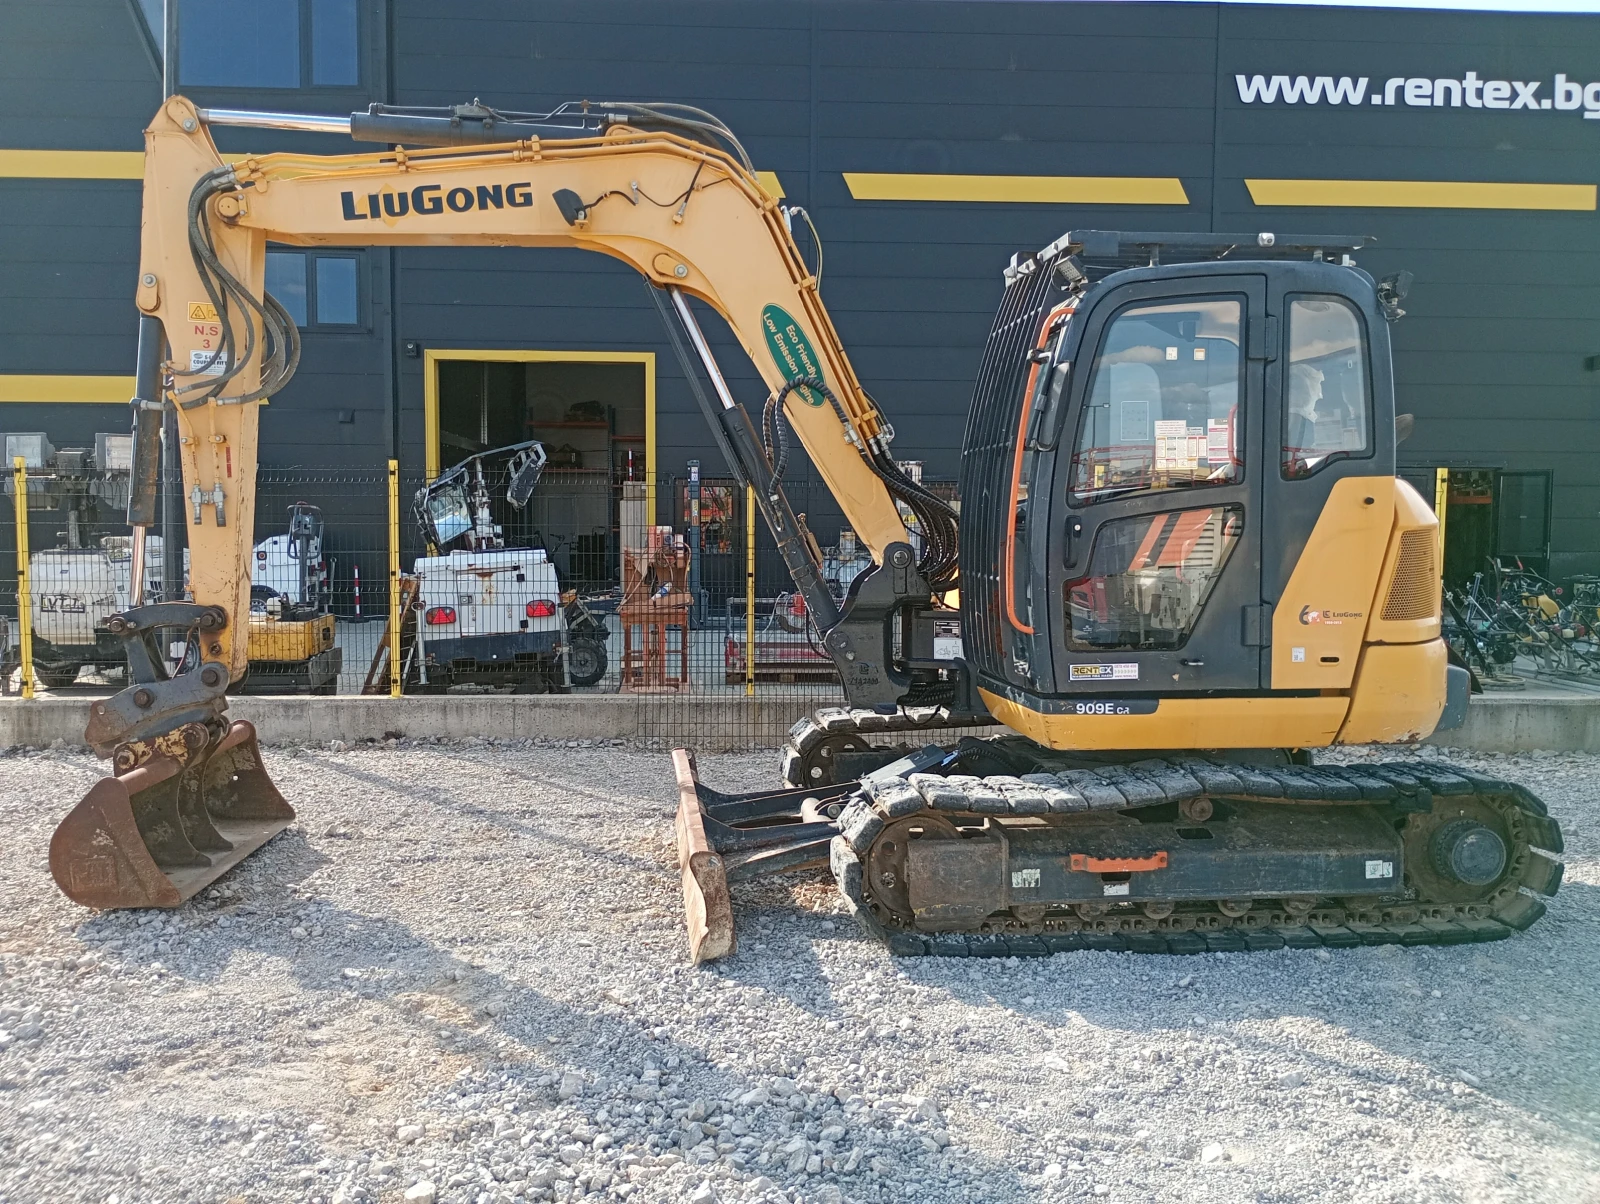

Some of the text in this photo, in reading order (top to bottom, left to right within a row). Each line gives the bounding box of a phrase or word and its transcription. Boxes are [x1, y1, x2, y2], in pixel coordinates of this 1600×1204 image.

[194, 325, 219, 336] N.S
[202, 338, 210, 348] 3
[786, 324, 818, 378] Eco Friendly
[763, 312, 815, 405] Low Emission Egine
[1076, 703, 1114, 715] 909E
